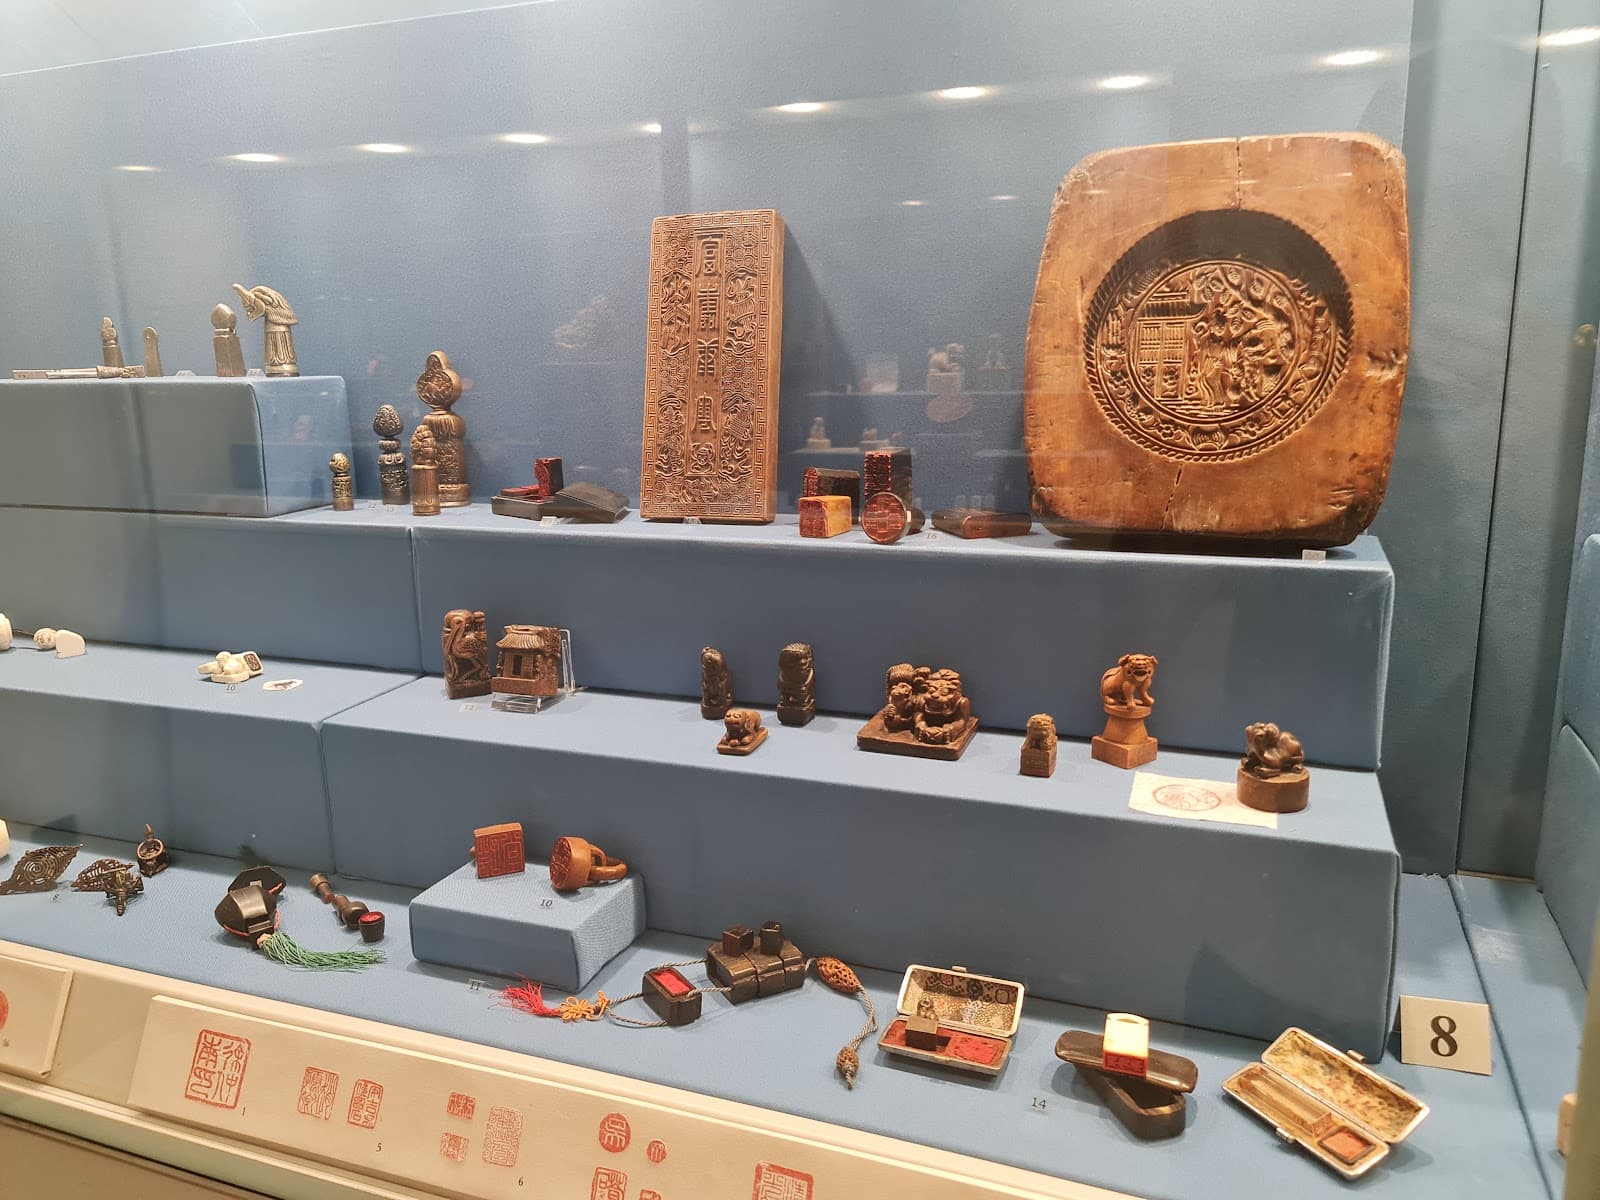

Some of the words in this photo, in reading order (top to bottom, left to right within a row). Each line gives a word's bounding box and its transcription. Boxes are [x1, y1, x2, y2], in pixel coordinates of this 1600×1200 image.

[540, 899, 553, 907] 10
[1430, 1015, 1458, 1057] 8
[1032, 1097, 1047, 1110] 14
[375, 1142, 383, 1152] 5
[518, 1176, 524, 1187] 6
